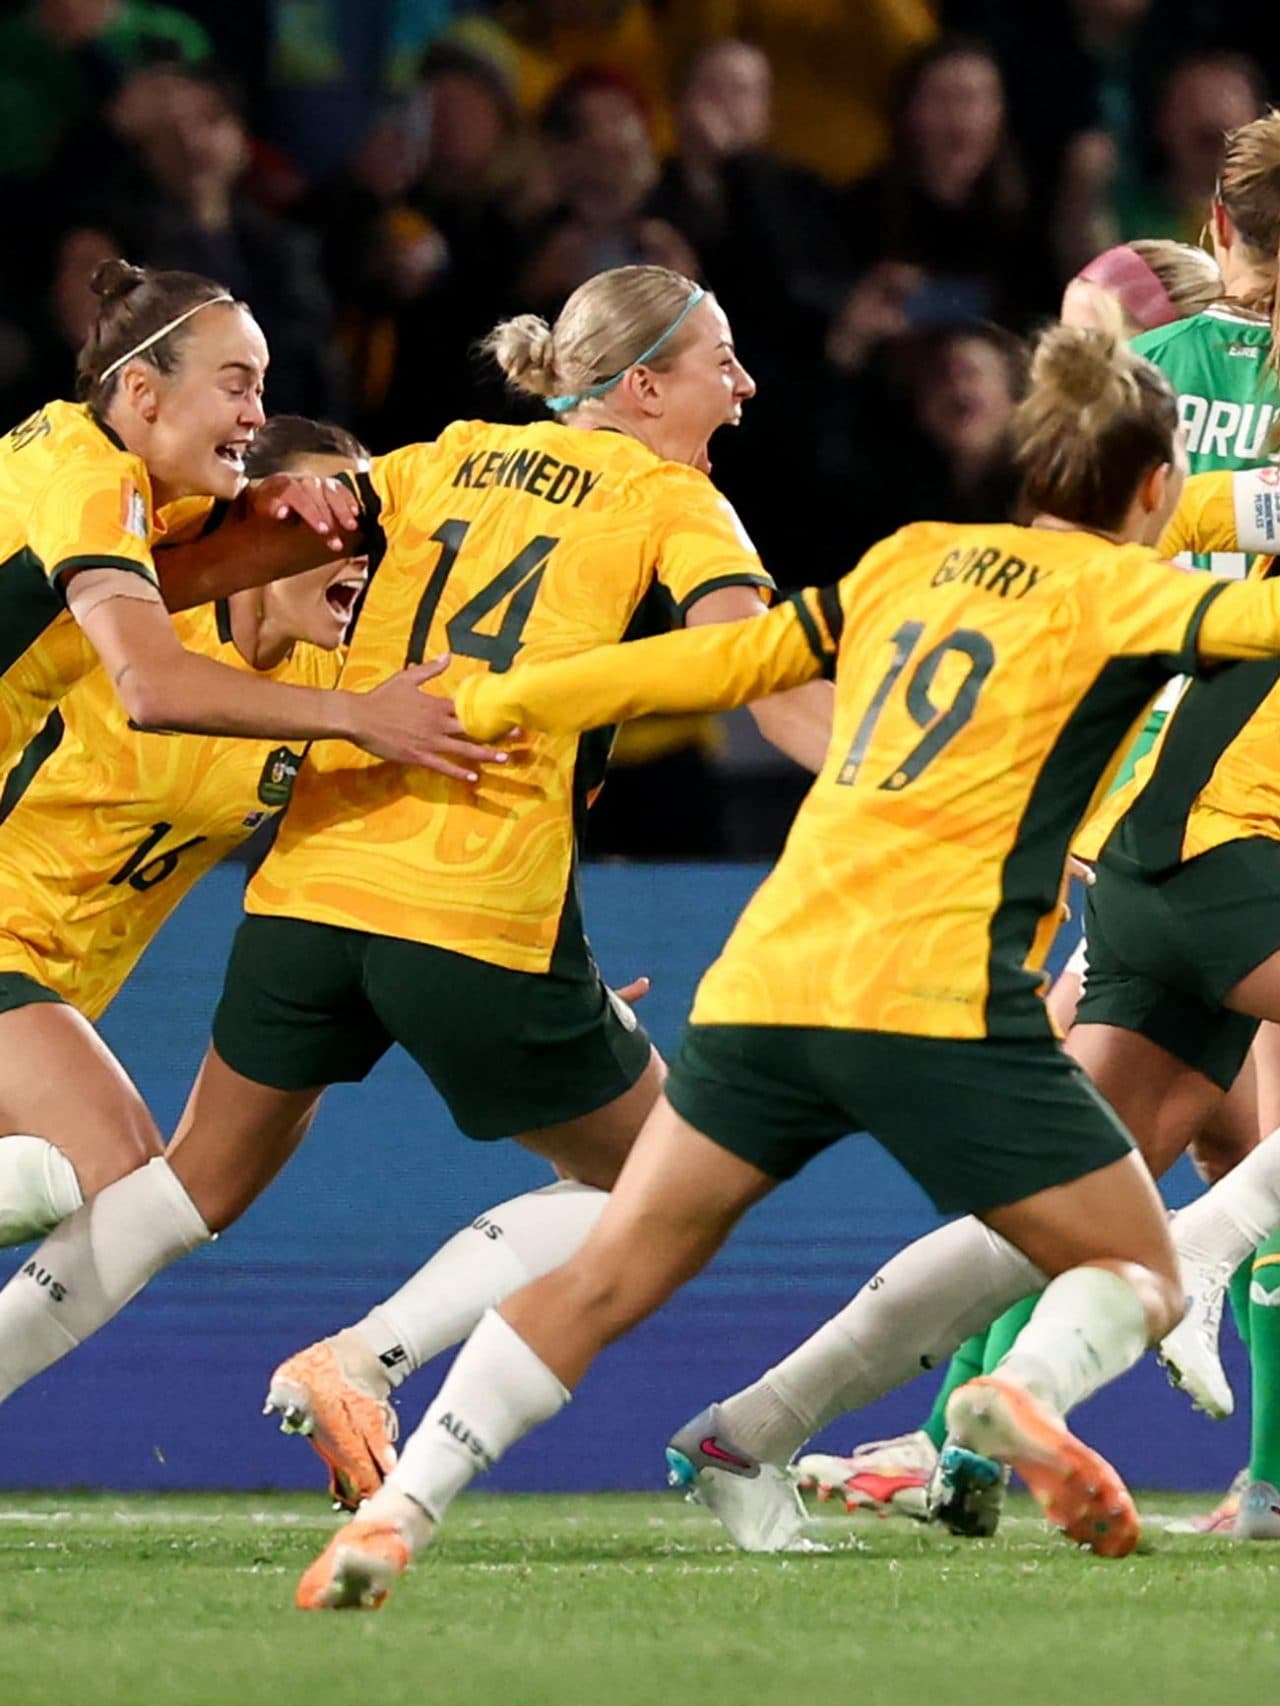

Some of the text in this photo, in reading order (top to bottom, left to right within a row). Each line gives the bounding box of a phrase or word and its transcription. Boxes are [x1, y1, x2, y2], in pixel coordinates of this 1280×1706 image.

[452, 449, 603, 508] KENNEDY
[404, 518, 559, 674] 14
[836, 620, 995, 790] 19
[109, 822, 206, 891] 16
[23, 1261, 66, 1302] AUS
[439, 1412, 483, 1456] AUS
